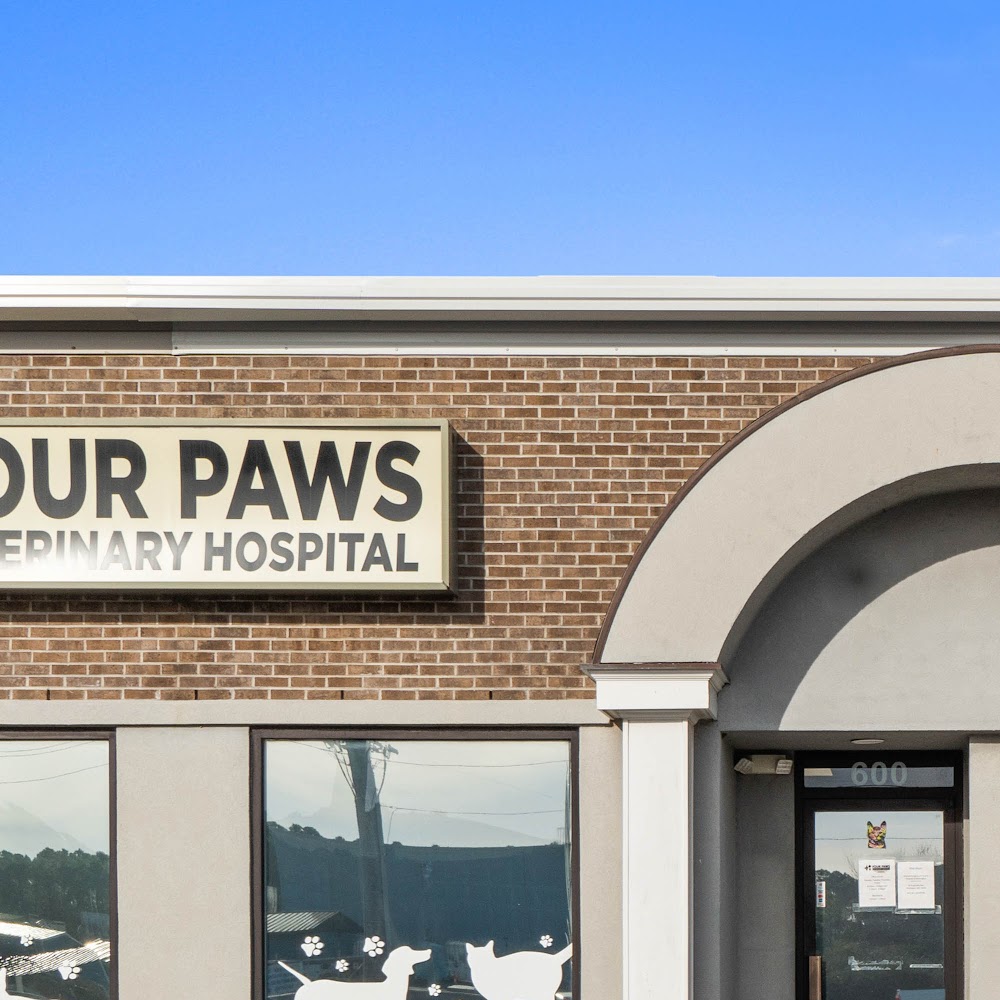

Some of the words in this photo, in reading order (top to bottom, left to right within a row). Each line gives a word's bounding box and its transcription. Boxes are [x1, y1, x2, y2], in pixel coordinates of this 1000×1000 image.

[180, 439, 423, 522] PAWS
[204, 531, 419, 572] HOSPITAL
[852, 762, 907, 786] 600
